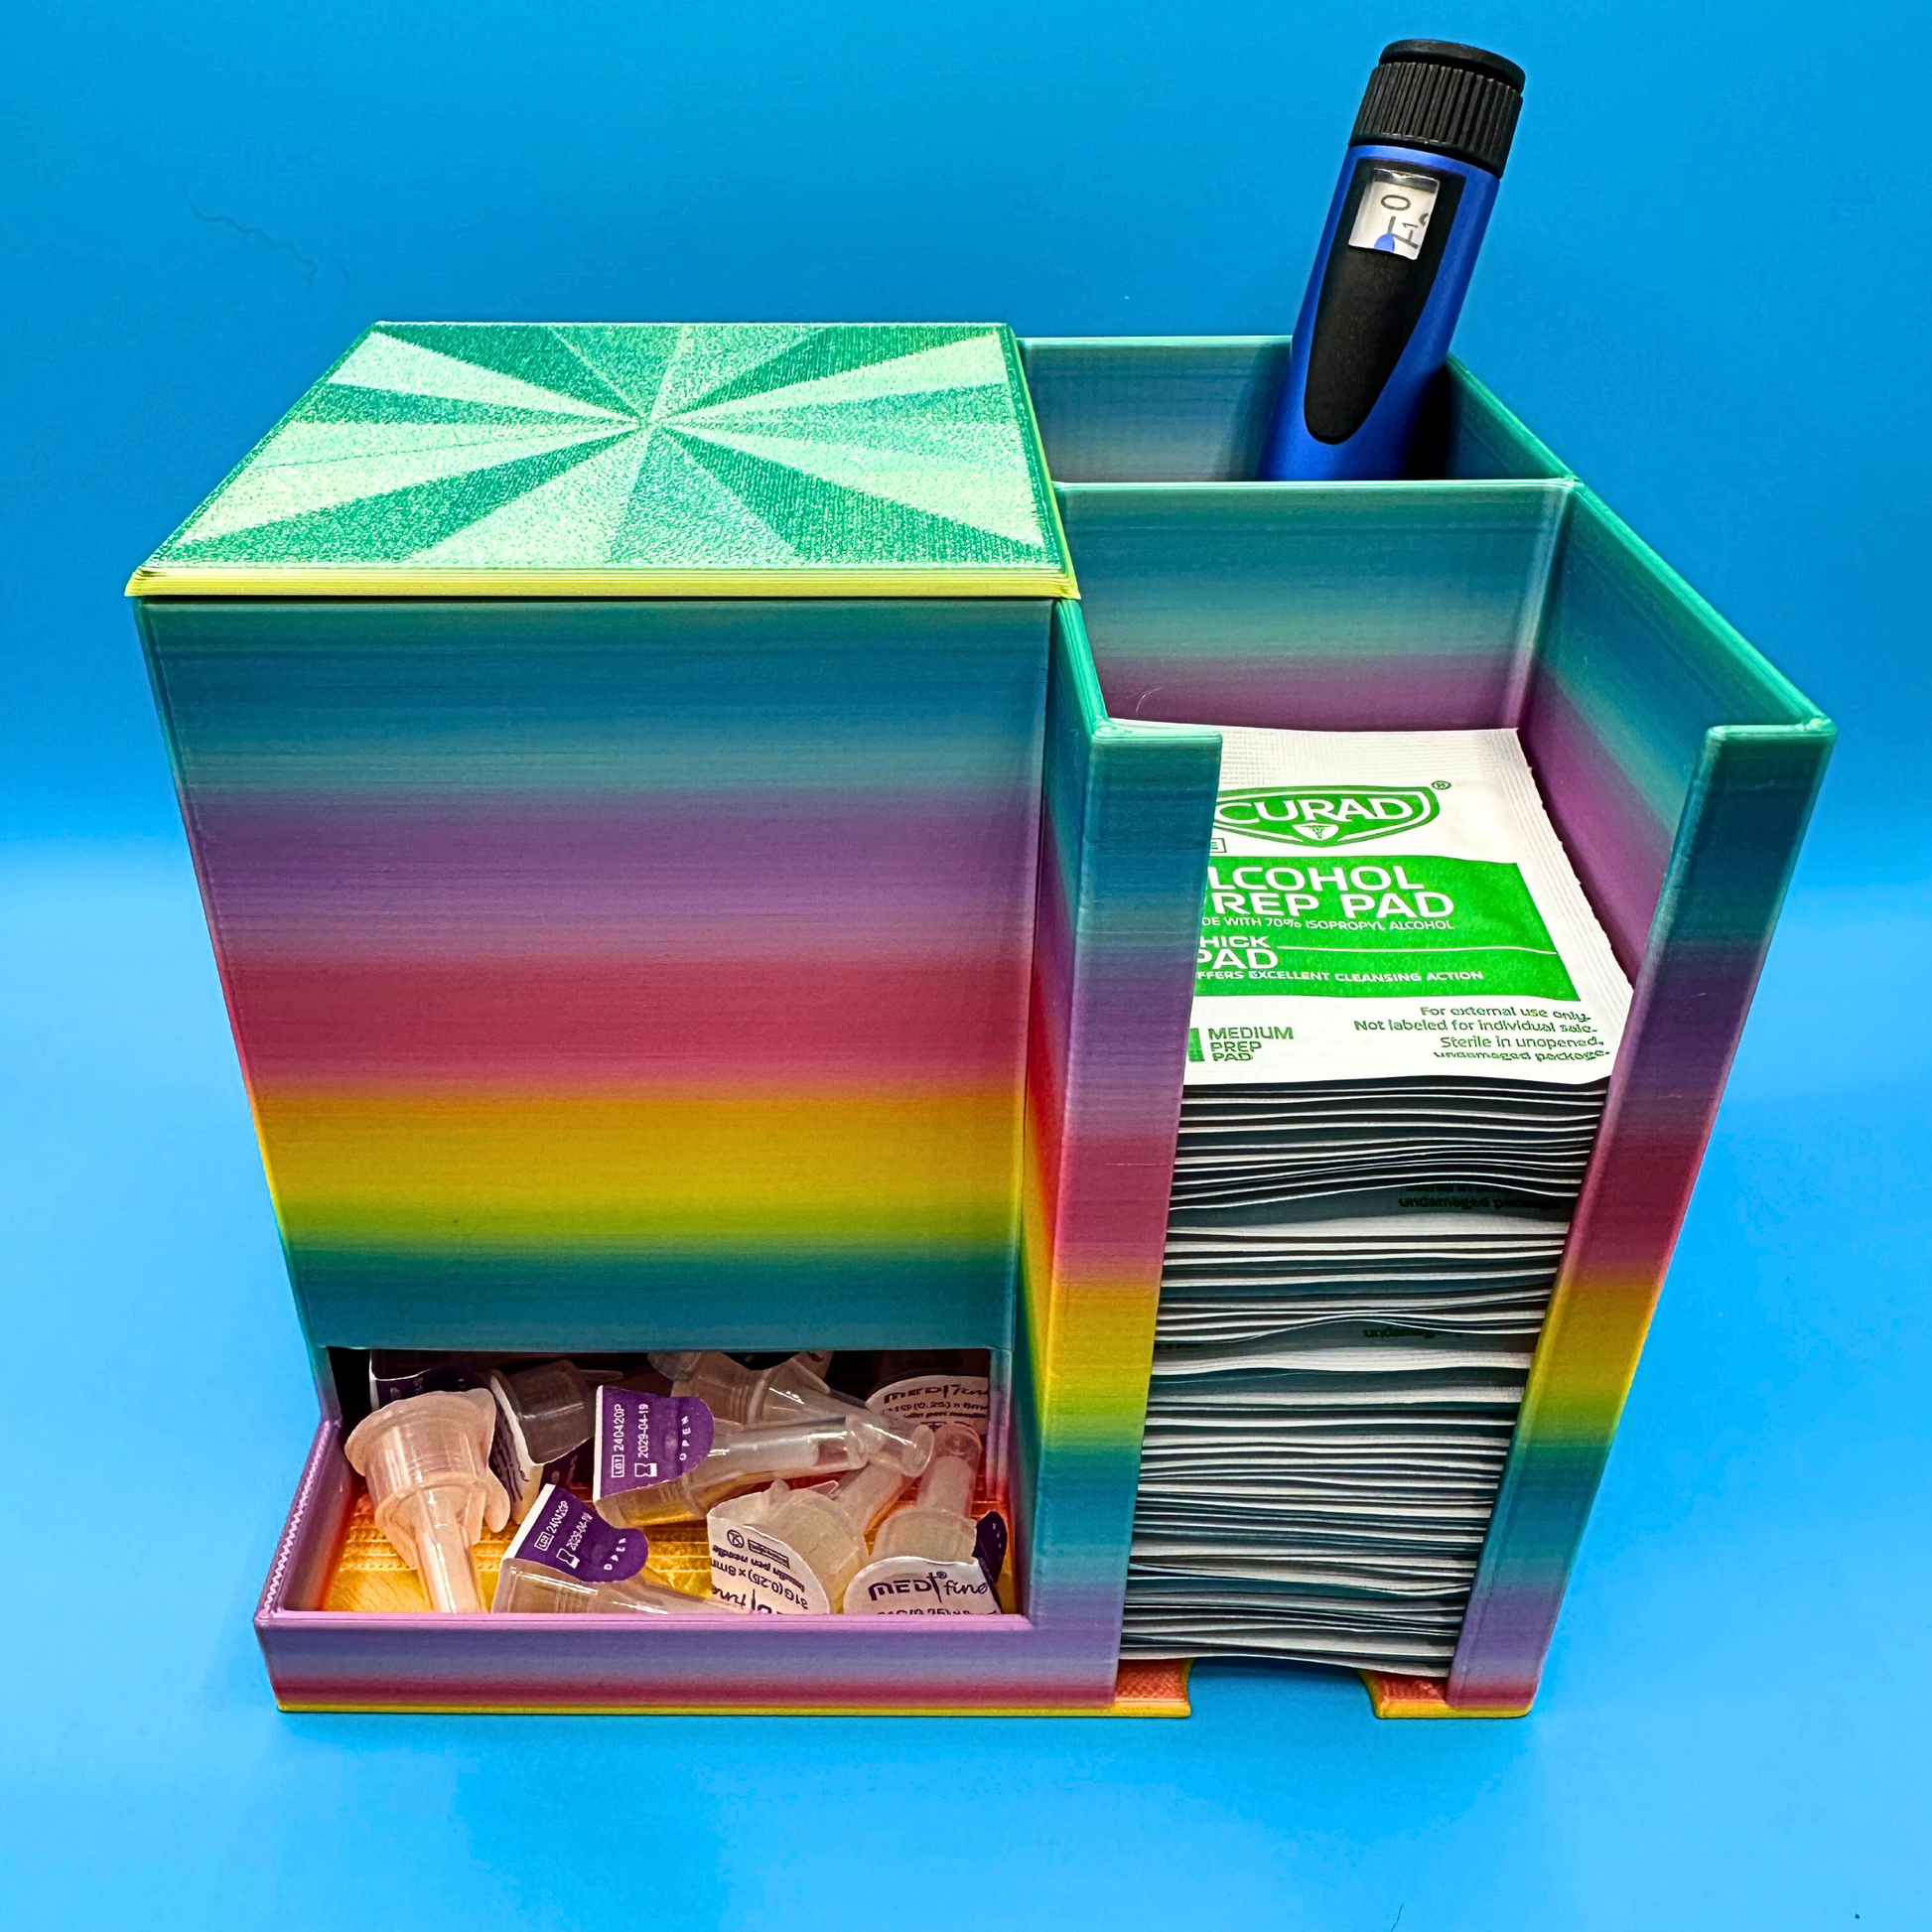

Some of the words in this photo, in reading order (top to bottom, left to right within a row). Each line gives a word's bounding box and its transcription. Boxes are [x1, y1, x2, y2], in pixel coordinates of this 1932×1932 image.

[1214, 797, 1414, 824] CURAD
[1207, 865, 1425, 892] LCOHOL
[1211, 892, 1319, 917] REP
[1340, 892, 1455, 919] PAD
[1201, 916, 1220, 926] DE
[1223, 916, 1263, 927] WITH
[1265, 917, 1302, 928] 70%
[1306, 919, 1386, 931] ISOPROPYL
[1390, 919, 1455, 931] ALCOHOL
[1199, 935, 1272, 948] HICK
[1196, 948, 1279, 970] PAD
[1196, 970, 1245, 980] FFERS
[1249, 970, 1330, 982] EXCELLENT
[1334, 972, 1423, 983] CLEANSING
[1427, 971, 1484, 981] ACTION
[1420, 1006, 1446, 1017] For
[1450, 1006, 1517, 1017] external
[1520, 1008, 1548, 1018] use
[1207, 1026, 1295, 1040] MEDIUM
[1353, 1020, 1386, 1032] Not
[1389, 1019, 1449, 1032] labeled
[1451, 1020, 1474, 1032] for
[1478, 1019, 1556, 1033] individual
[1209, 1040, 1263, 1052] PREP
[1441, 1035, 1492, 1048] Sterile
[1495, 1035, 1512, 1048] in
[1211, 1052, 1254, 1062] PAD
